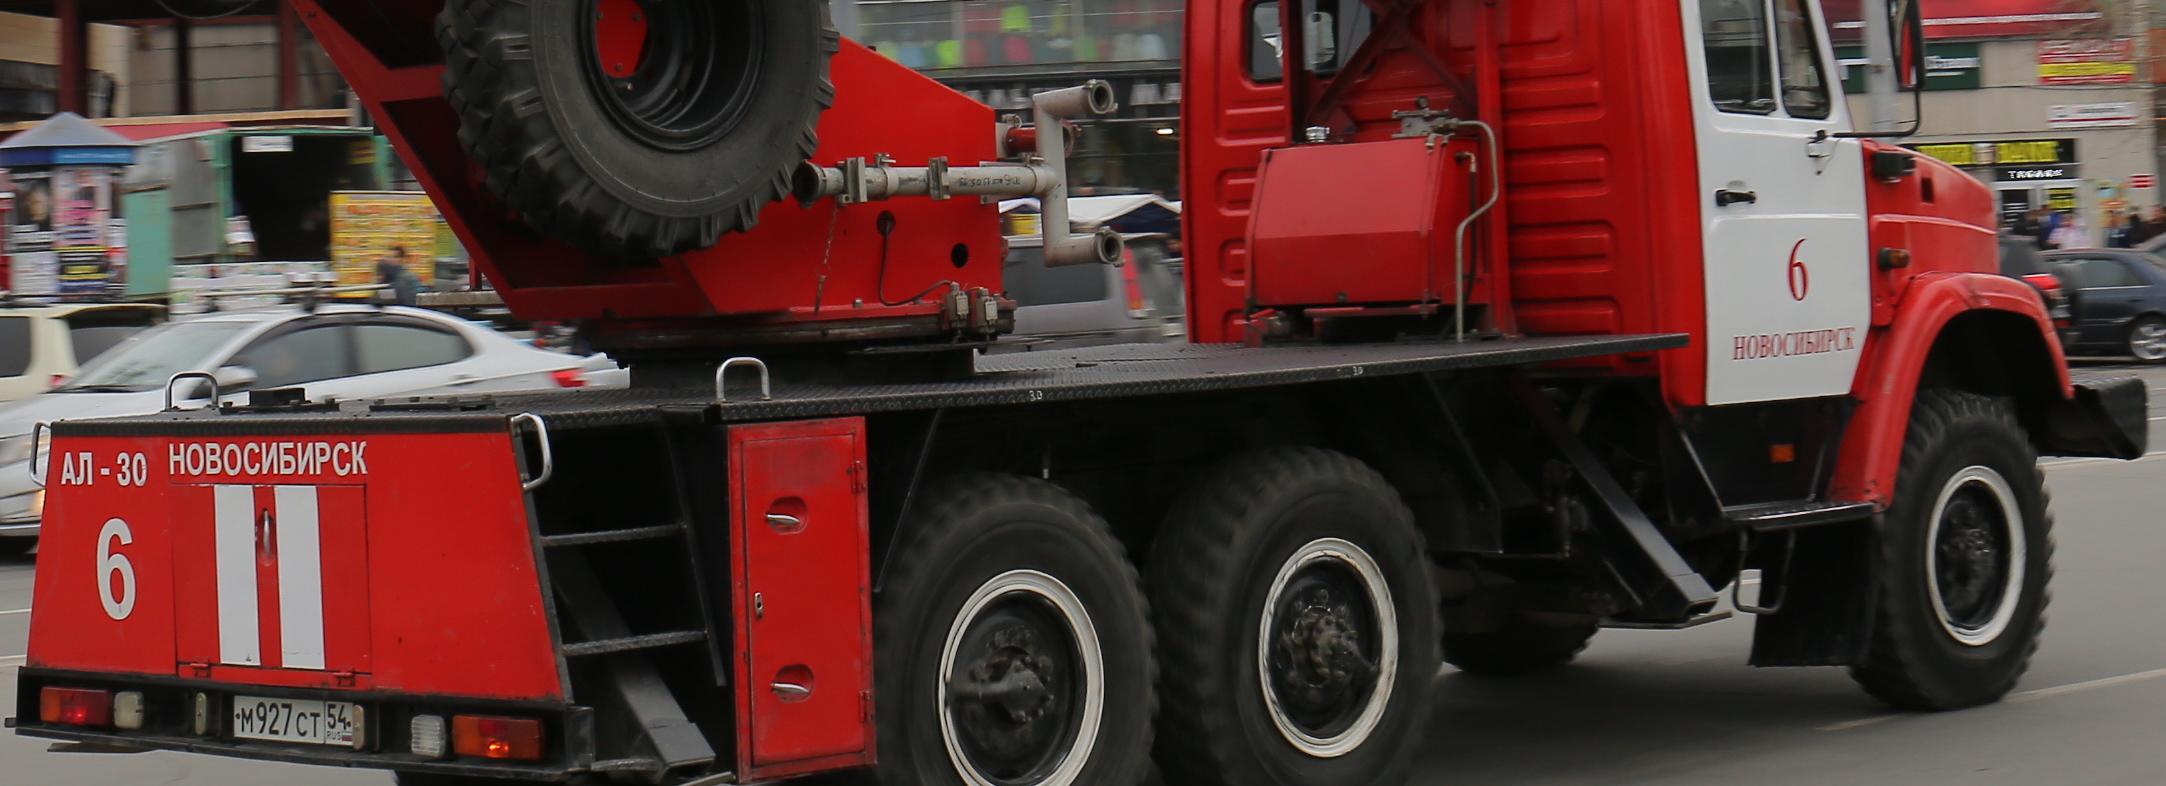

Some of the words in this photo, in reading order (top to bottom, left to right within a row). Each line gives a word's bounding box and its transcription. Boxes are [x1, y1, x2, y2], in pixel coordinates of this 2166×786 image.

[1788, 238, 1809, 301] 6
[1732, 327, 1856, 361] НОВОСИБИРСК
[1029, 390, 1043, 402] 30
[60, 452, 93, 486] АЛ
[116, 452, 148, 486] 30
[168, 441, 368, 477] НОВОСИБИРСК
[96, 517, 137, 621] 6
[327, 704, 347, 730] 54
